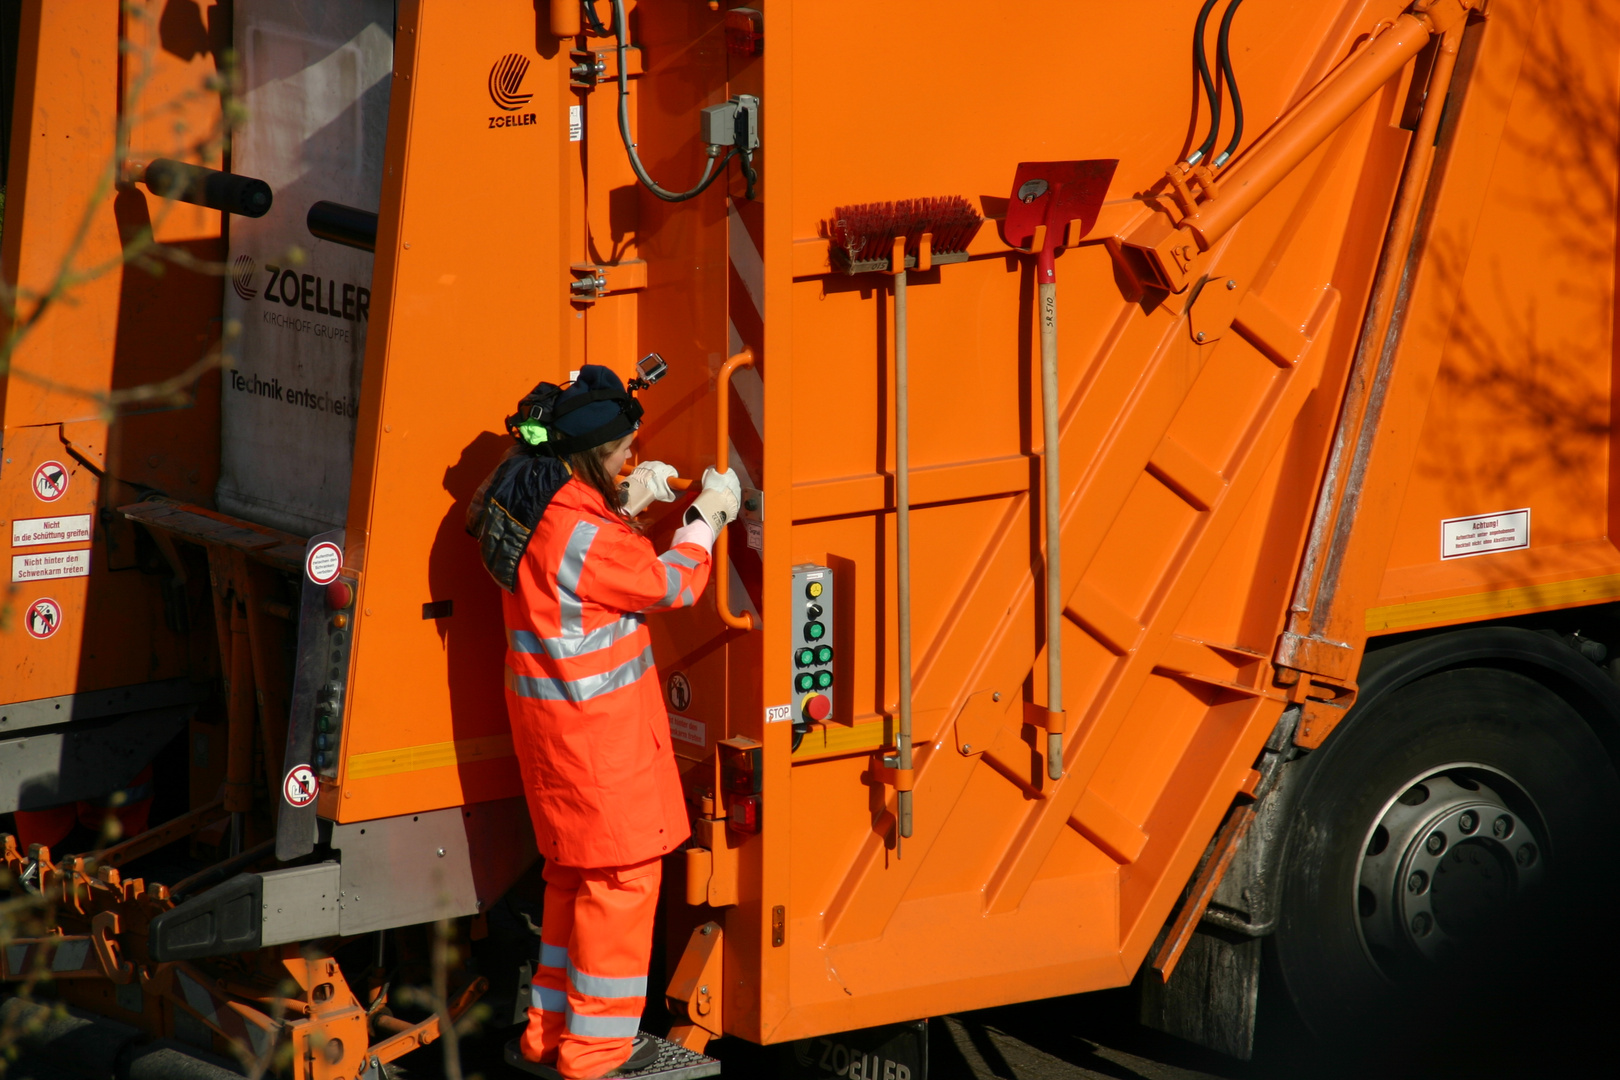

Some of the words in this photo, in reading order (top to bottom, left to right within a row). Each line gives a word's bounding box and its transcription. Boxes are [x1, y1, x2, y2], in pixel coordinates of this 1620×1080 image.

[488, 113, 537, 129] ZOELLER
[264, 264, 371, 323] ZOELLER
[1045, 297, 1053, 315] 510
[263, 310, 311, 333] KIRCHHOFF
[313, 323, 350, 343] GRUPPE
[230, 369, 283, 401] Technik
[43, 521, 60, 529] Nicht
[1472, 519, 1499, 530] Achtung!
[14, 534, 20, 542] in
[21, 533, 31, 541] die
[33, 531, 65, 540] Schüttung
[66, 529, 88, 539] greifen
[24, 558, 42, 566] Nicht
[44, 556, 64, 564] hinter
[18, 568, 61, 578] Schwenkarm
[63, 566, 84, 574] treten
[768, 706, 790, 719] STOP
